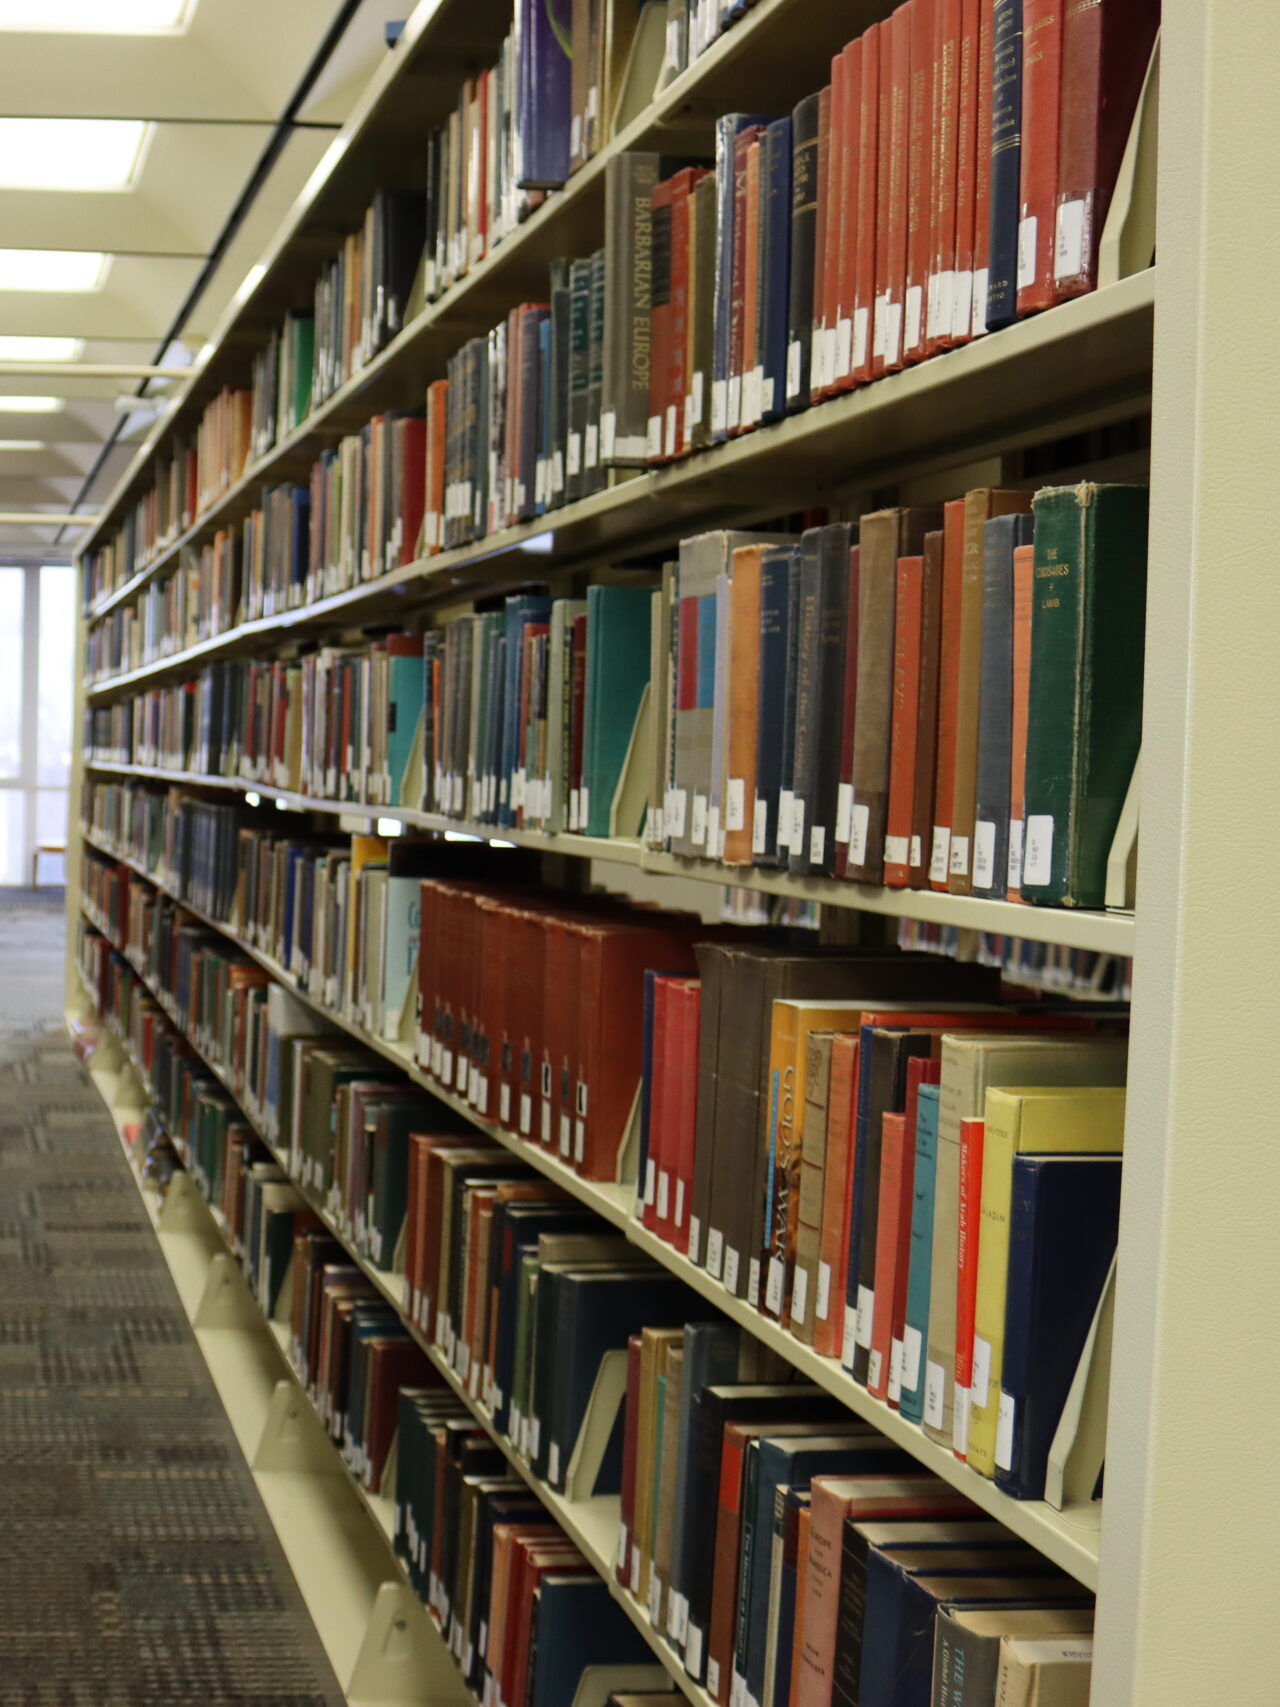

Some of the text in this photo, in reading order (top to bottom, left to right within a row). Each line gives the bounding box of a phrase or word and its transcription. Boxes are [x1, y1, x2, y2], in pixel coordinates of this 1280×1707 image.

[632, 197, 651, 391] BARBARIAN EUROPE
[1047, 548, 1058, 561] THE
[1035, 563, 1069, 579] CRUSADES
[1041, 598, 1061, 609] LAMB
[802, 595, 815, 661] History
[894, 572, 908, 710] THE SLAVS
[802, 667, 812, 686] of
[799, 692, 812, 718] the
[957, 1142, 968, 1270] Makers of Arab History
[810, 1526, 832, 1550] EUROPE
[941, 1649, 950, 1684] Global
[953, 1648, 965, 1687] THE
